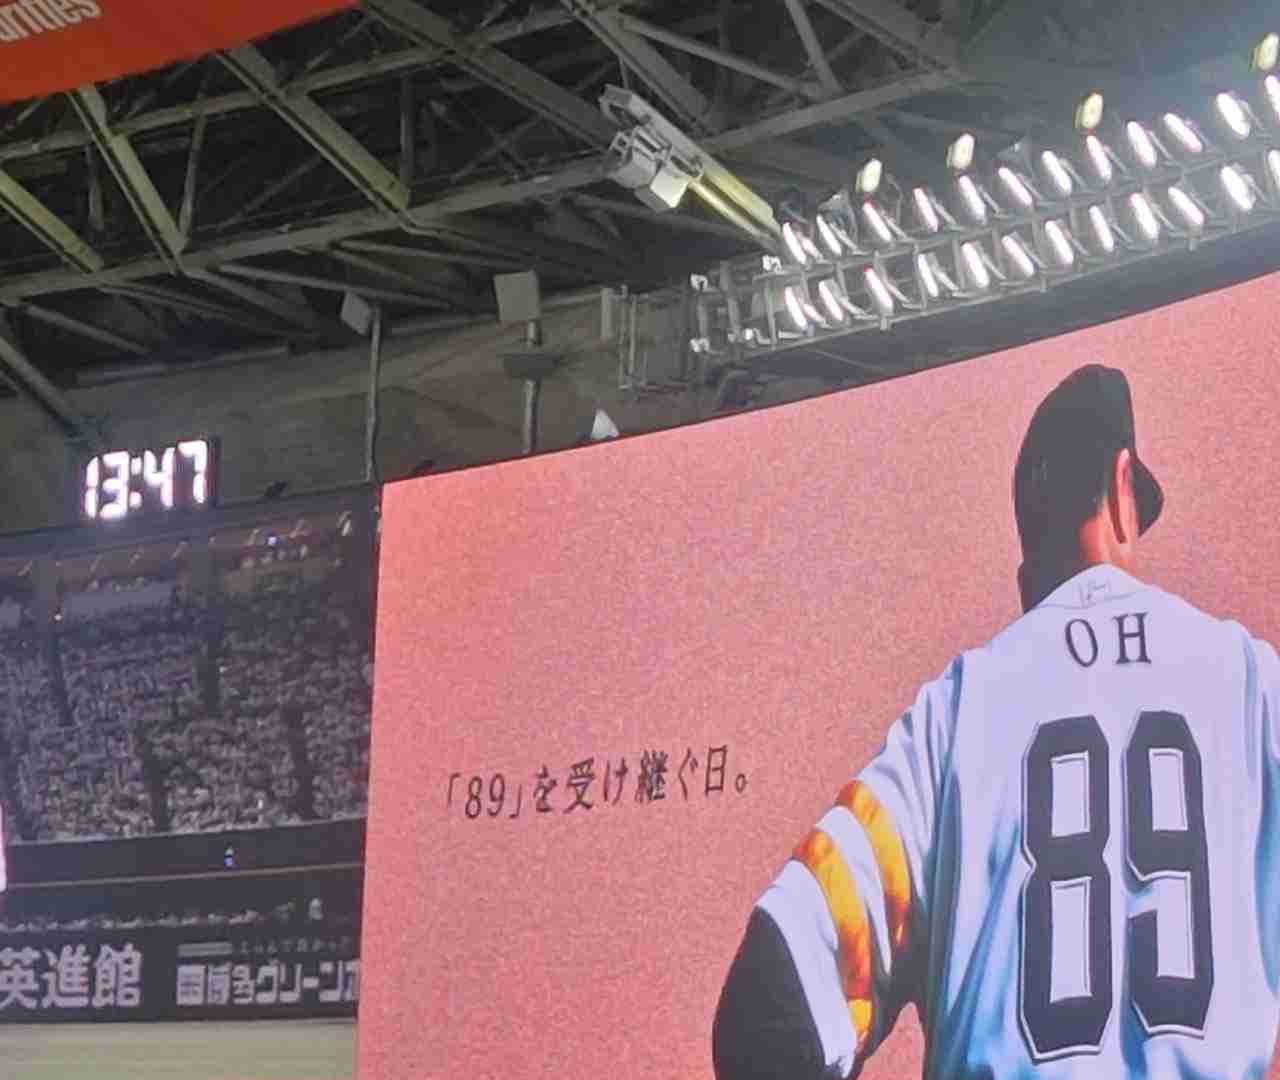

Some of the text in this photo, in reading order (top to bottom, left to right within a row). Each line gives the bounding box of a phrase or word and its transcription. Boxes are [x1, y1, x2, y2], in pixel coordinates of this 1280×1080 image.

[82, 440, 209, 520] 13:47
[1064, 611, 1154, 668] OH
[1018, 709, 1215, 1065] 89
